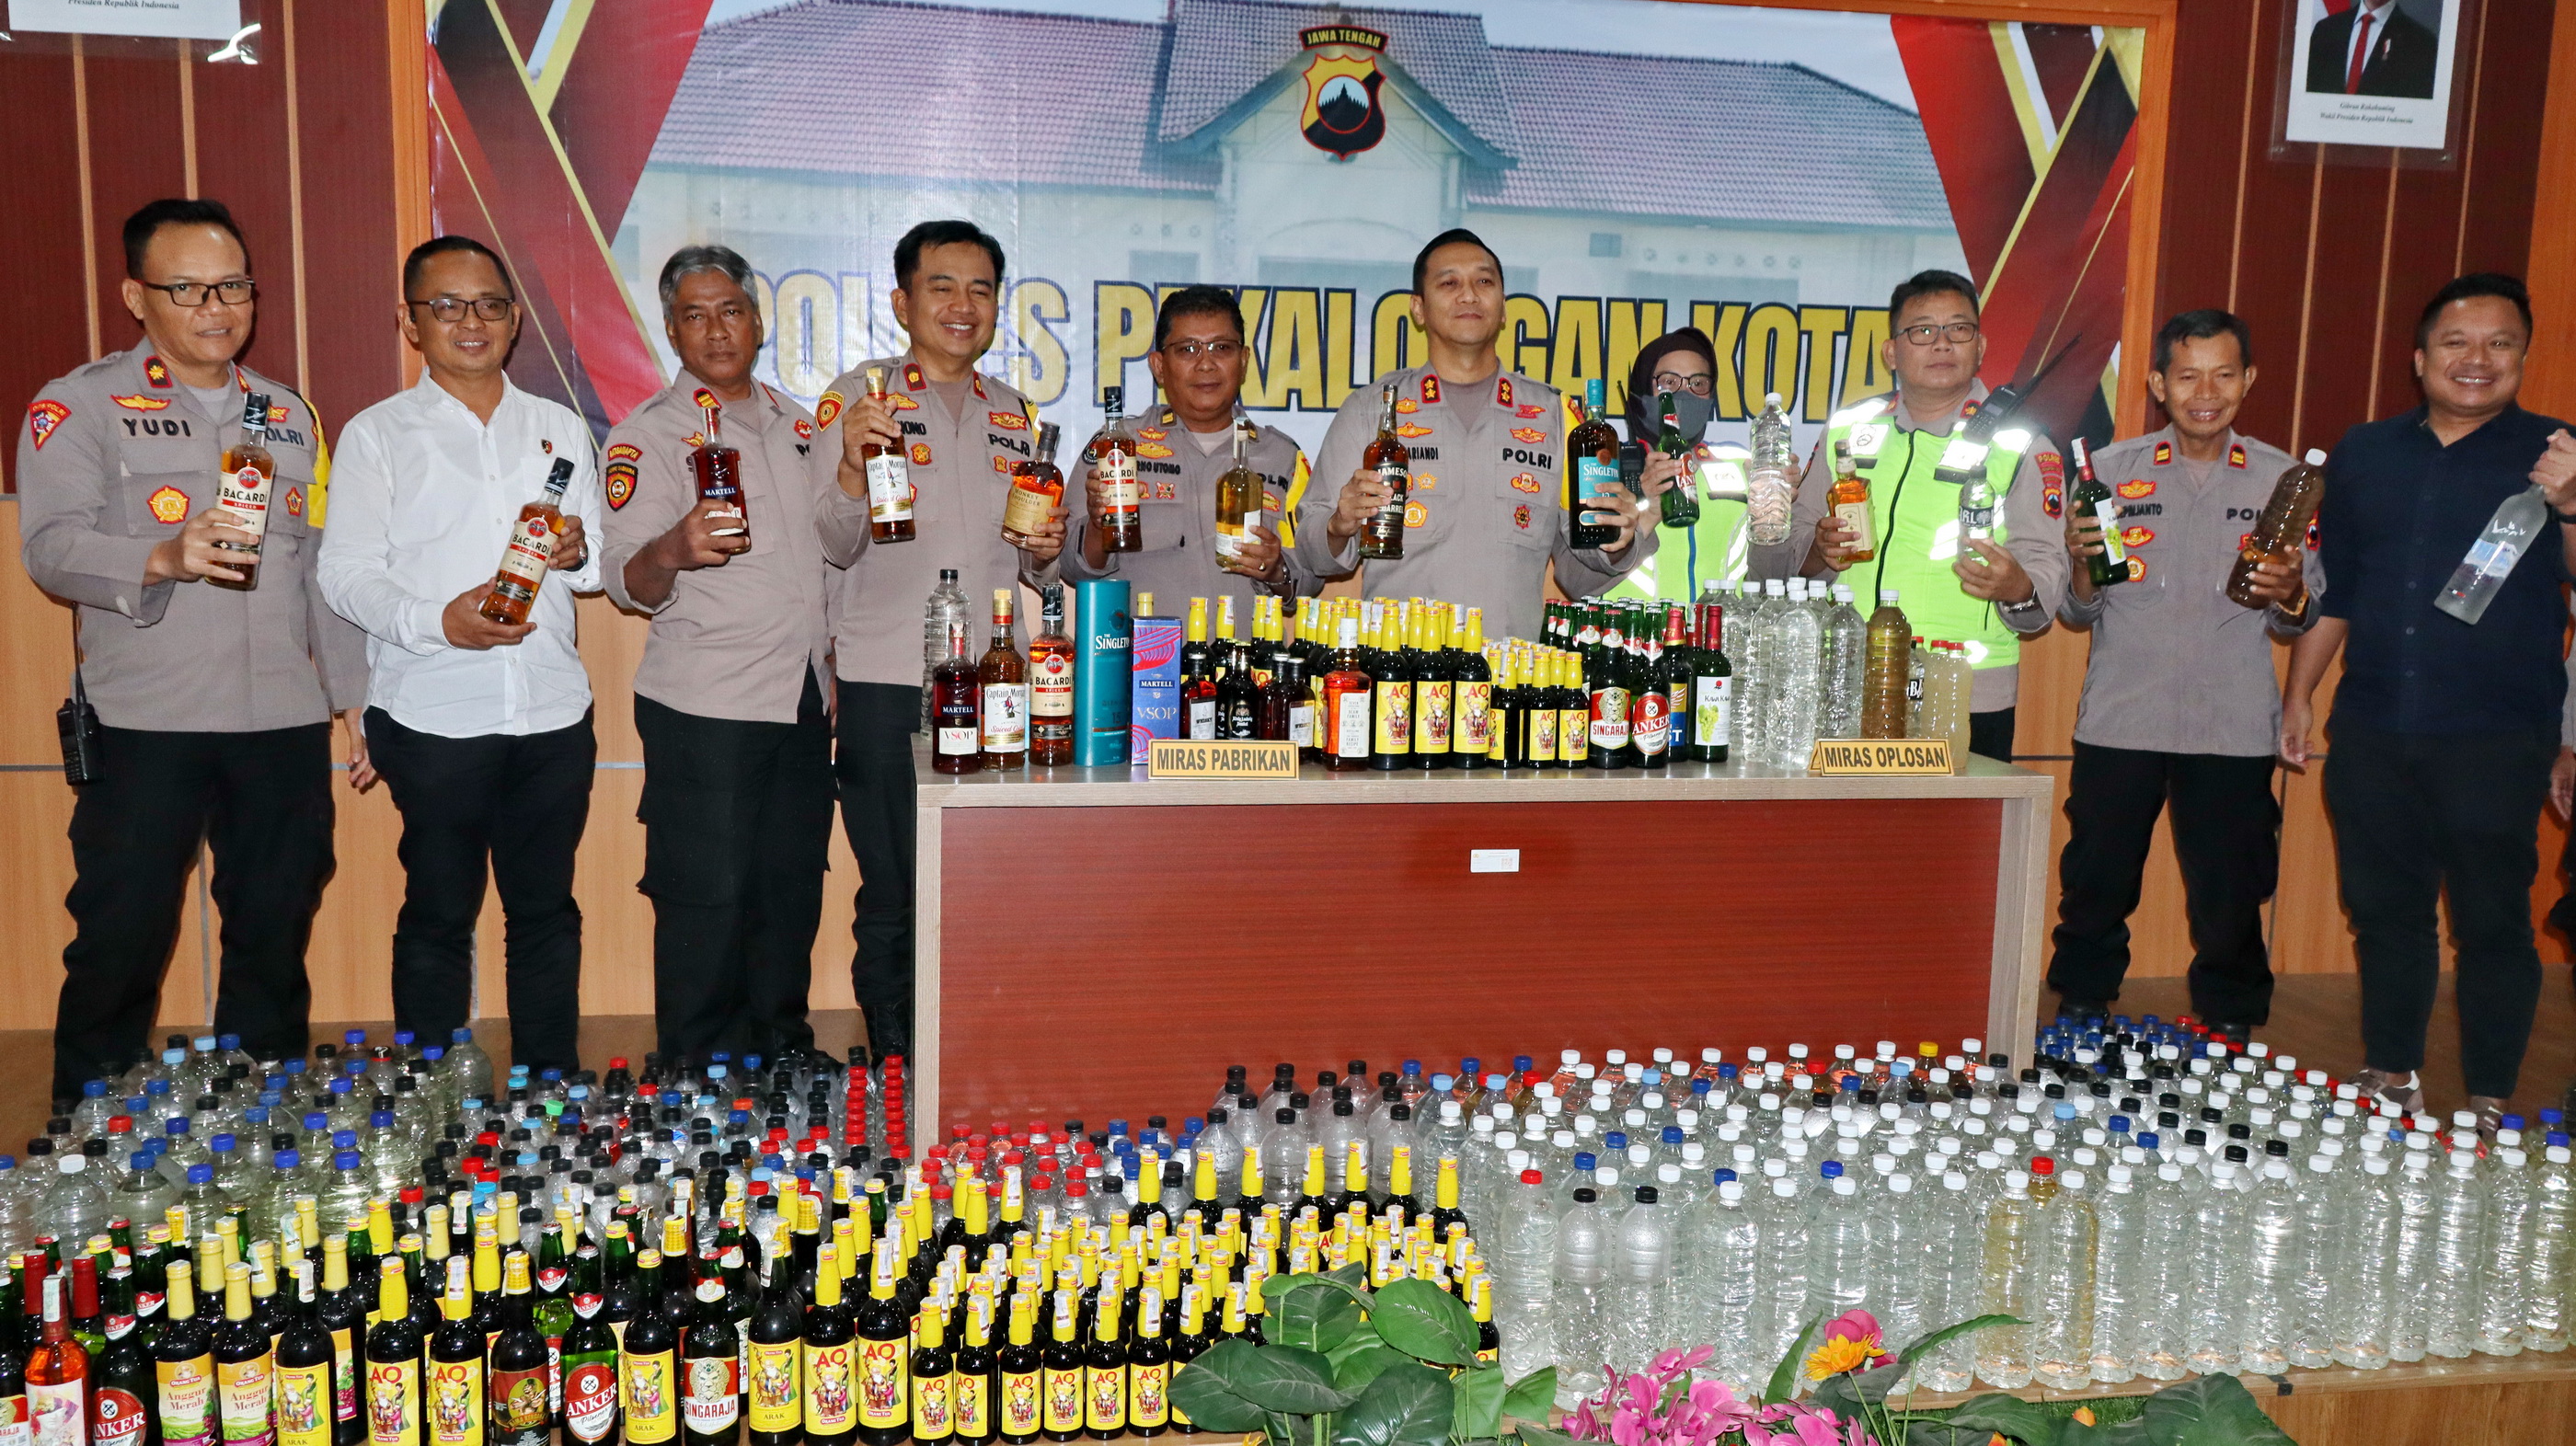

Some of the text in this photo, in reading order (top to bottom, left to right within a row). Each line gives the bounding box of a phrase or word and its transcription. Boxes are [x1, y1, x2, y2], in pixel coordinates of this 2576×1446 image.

[141, 0, 180, 9] Indonesia
[1306, 29, 1381, 47] JAWA TENGAH
[1093, 279, 1668, 420] PKALOGAN
[122, 418, 191, 438] YUDI
[265, 427, 305, 447] OLRI
[1408, 446, 1439, 461] ARIANDI
[1502, 447, 1552, 470] POLRI
[867, 461, 888, 473] Captai
[1378, 467, 1408, 478] JAMESO
[705, 487, 736, 497] MARTELL
[1015, 488, 1039, 499] MONKEY
[1390, 493, 1404, 502] LACK
[1095, 635, 1130, 649] SINGLETO
[985, 688, 1009, 702] Captain
[1390, 683, 1409, 698] AO
[1430, 683, 1449, 698] AO
[1468, 683, 1489, 698] AO
[942, 705, 973, 714] MARTELL
[1136, 706, 1178, 720] VSOP
[1632, 714, 1670, 734] ANKER
[944, 730, 973, 740] VSOP
[1157, 747, 1291, 772] MIRAS PABRIKAN
[1823, 747, 1947, 768] MIRAS OPLOSAN
[137, 1300, 155, 1310] NKER
[815, 1348, 847, 1368] AO
[865, 1342, 896, 1361] AO
[371, 1365, 402, 1383] AO
[435, 1364, 467, 1383] AO
[1053, 1372, 1075, 1384] AO
[1096, 1371, 1118, 1383] AO
[1140, 1368, 1162, 1380] AO
[171, 1375, 201, 1387] ORANG TUA
[236, 1378, 254, 1387] ORANG
[924, 1378, 945, 1393] AO
[956, 1376, 975, 1389] AO
[1012, 1375, 1033, 1388] AO
[167, 1387, 207, 1401] Anggur
[230, 1385, 270, 1401] Anggur
[566, 1382, 617, 1417] ANKER
[170, 1399, 204, 1411] Merah
[235, 1397, 267, 1411] Merah
[684, 1400, 736, 1418] SINGARAJA
[763, 1412, 786, 1420] ARAK
